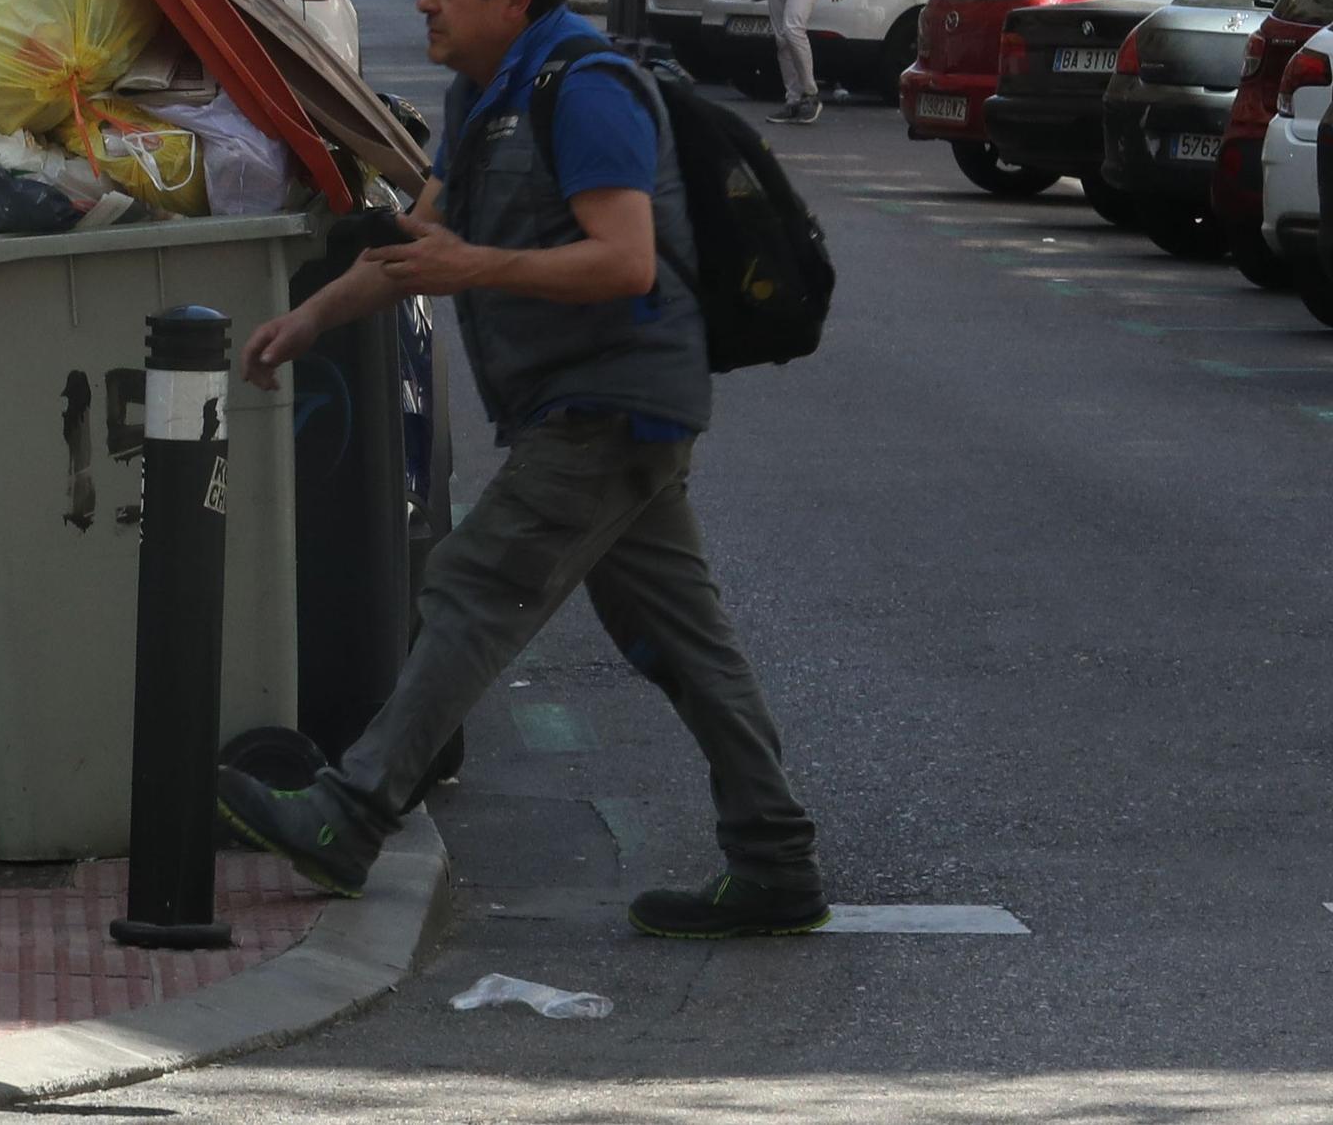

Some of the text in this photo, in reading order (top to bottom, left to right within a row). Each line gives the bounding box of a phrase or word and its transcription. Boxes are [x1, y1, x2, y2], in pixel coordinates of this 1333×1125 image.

[1061, 49, 1116, 71] BA 3110
[1181, 135, 1221, 156] 5762
